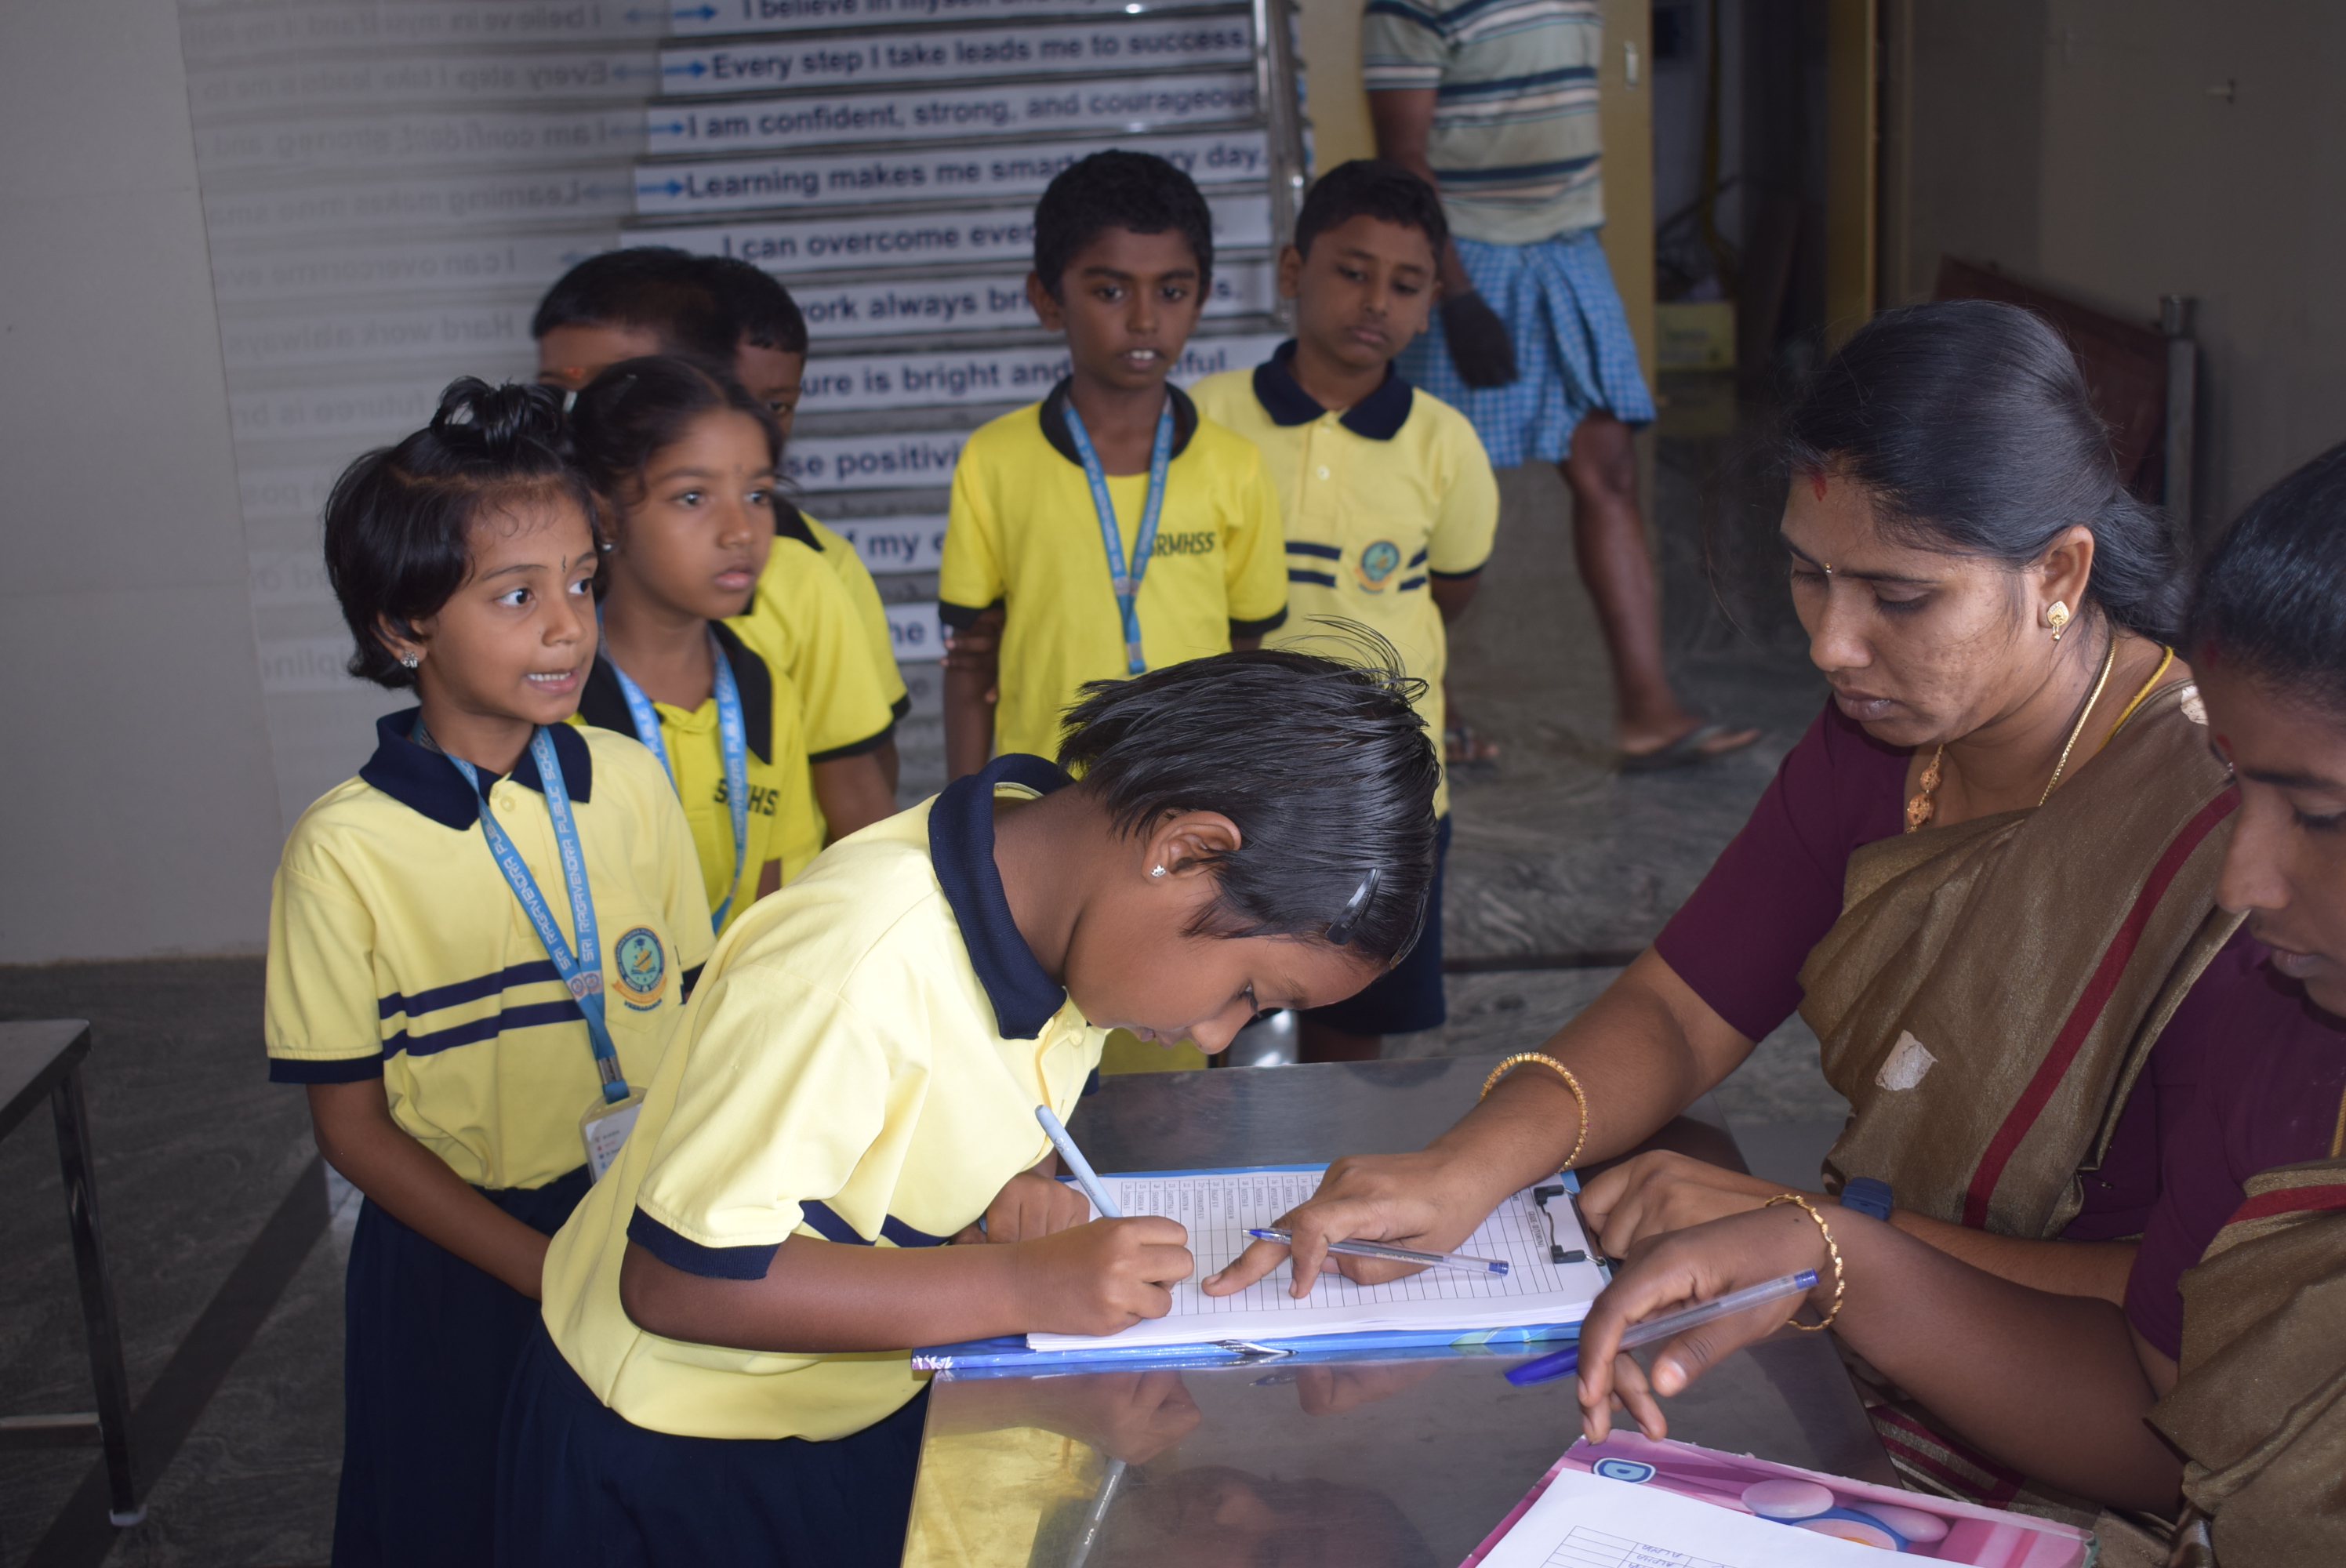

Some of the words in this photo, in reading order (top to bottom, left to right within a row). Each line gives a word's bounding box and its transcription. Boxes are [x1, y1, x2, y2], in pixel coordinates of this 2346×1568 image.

[712, 53, 793, 81] Every
[801, 48, 863, 76] step
[870, 45, 879, 69] I
[887, 42, 946, 68] take
[956, 34, 1031, 63] leads
[1040, 38, 1083, 59] me
[1091, 32, 1120, 56] to
[688, 113, 697, 138] I
[706, 116, 751, 138] am
[758, 103, 906, 136] confident,
[913, 100, 1017, 127] strong,
[1026, 92, 1080, 118] and
[687, 166, 819, 200] Learning
[829, 161, 926, 190] makes
[935, 162, 982, 183] me
[723, 234, 732, 259] I
[741, 235, 797, 261] can
[806, 226, 958, 257] overcome
[868, 290, 978, 322] always
[863, 365, 892, 394] is
[902, 360, 1000, 397] bright
[837, 440, 960, 481] positivi
[867, 533, 920, 563] my
[552, 786, 571, 833] PUBLIC
[562, 838, 593, 934] RAGAVENDRA
[554, 946, 572, 971] SRI
[579, 938, 594, 962] SRI
